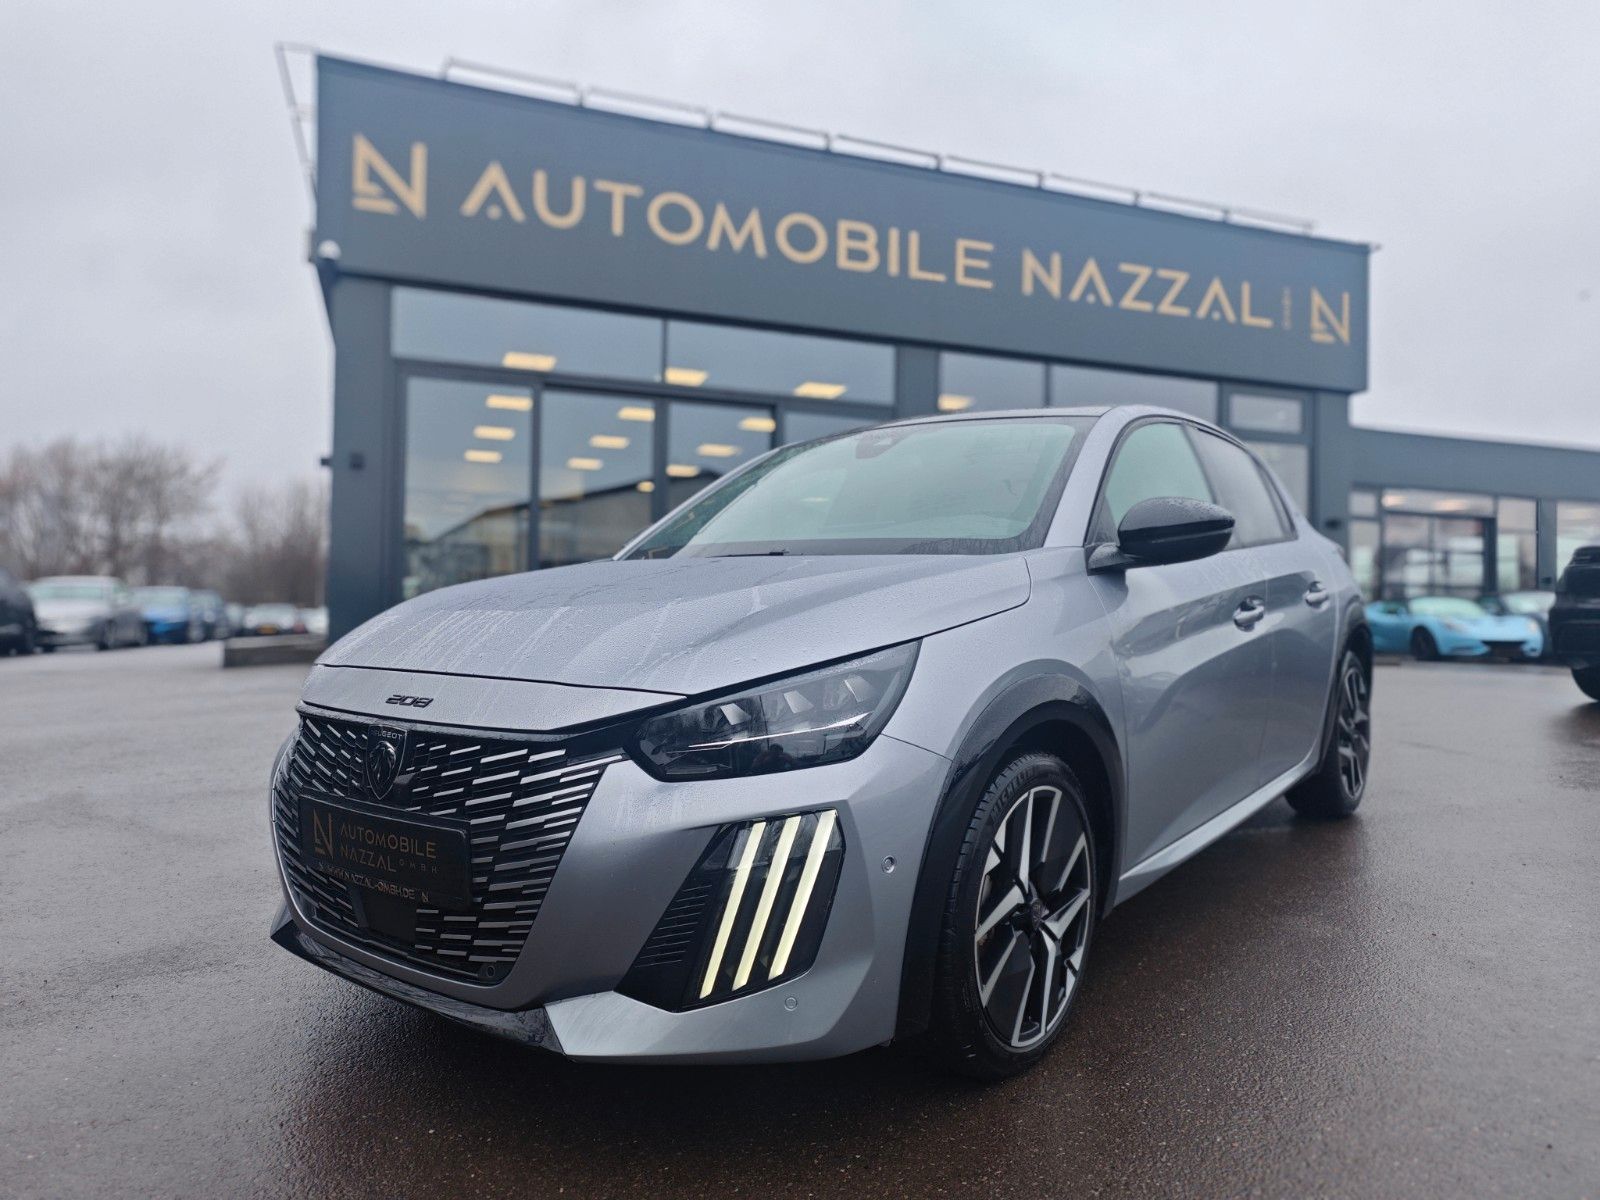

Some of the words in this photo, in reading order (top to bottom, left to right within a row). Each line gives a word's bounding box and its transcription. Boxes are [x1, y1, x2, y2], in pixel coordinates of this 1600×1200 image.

[460, 161, 994, 289] AUTOMOBILE
[1020, 247, 1273, 329] NAZZAL
[385, 694, 433, 708] 208
[340, 822, 437, 859] AUTOMOBILE
[340, 845, 397, 873] NAZZAL
